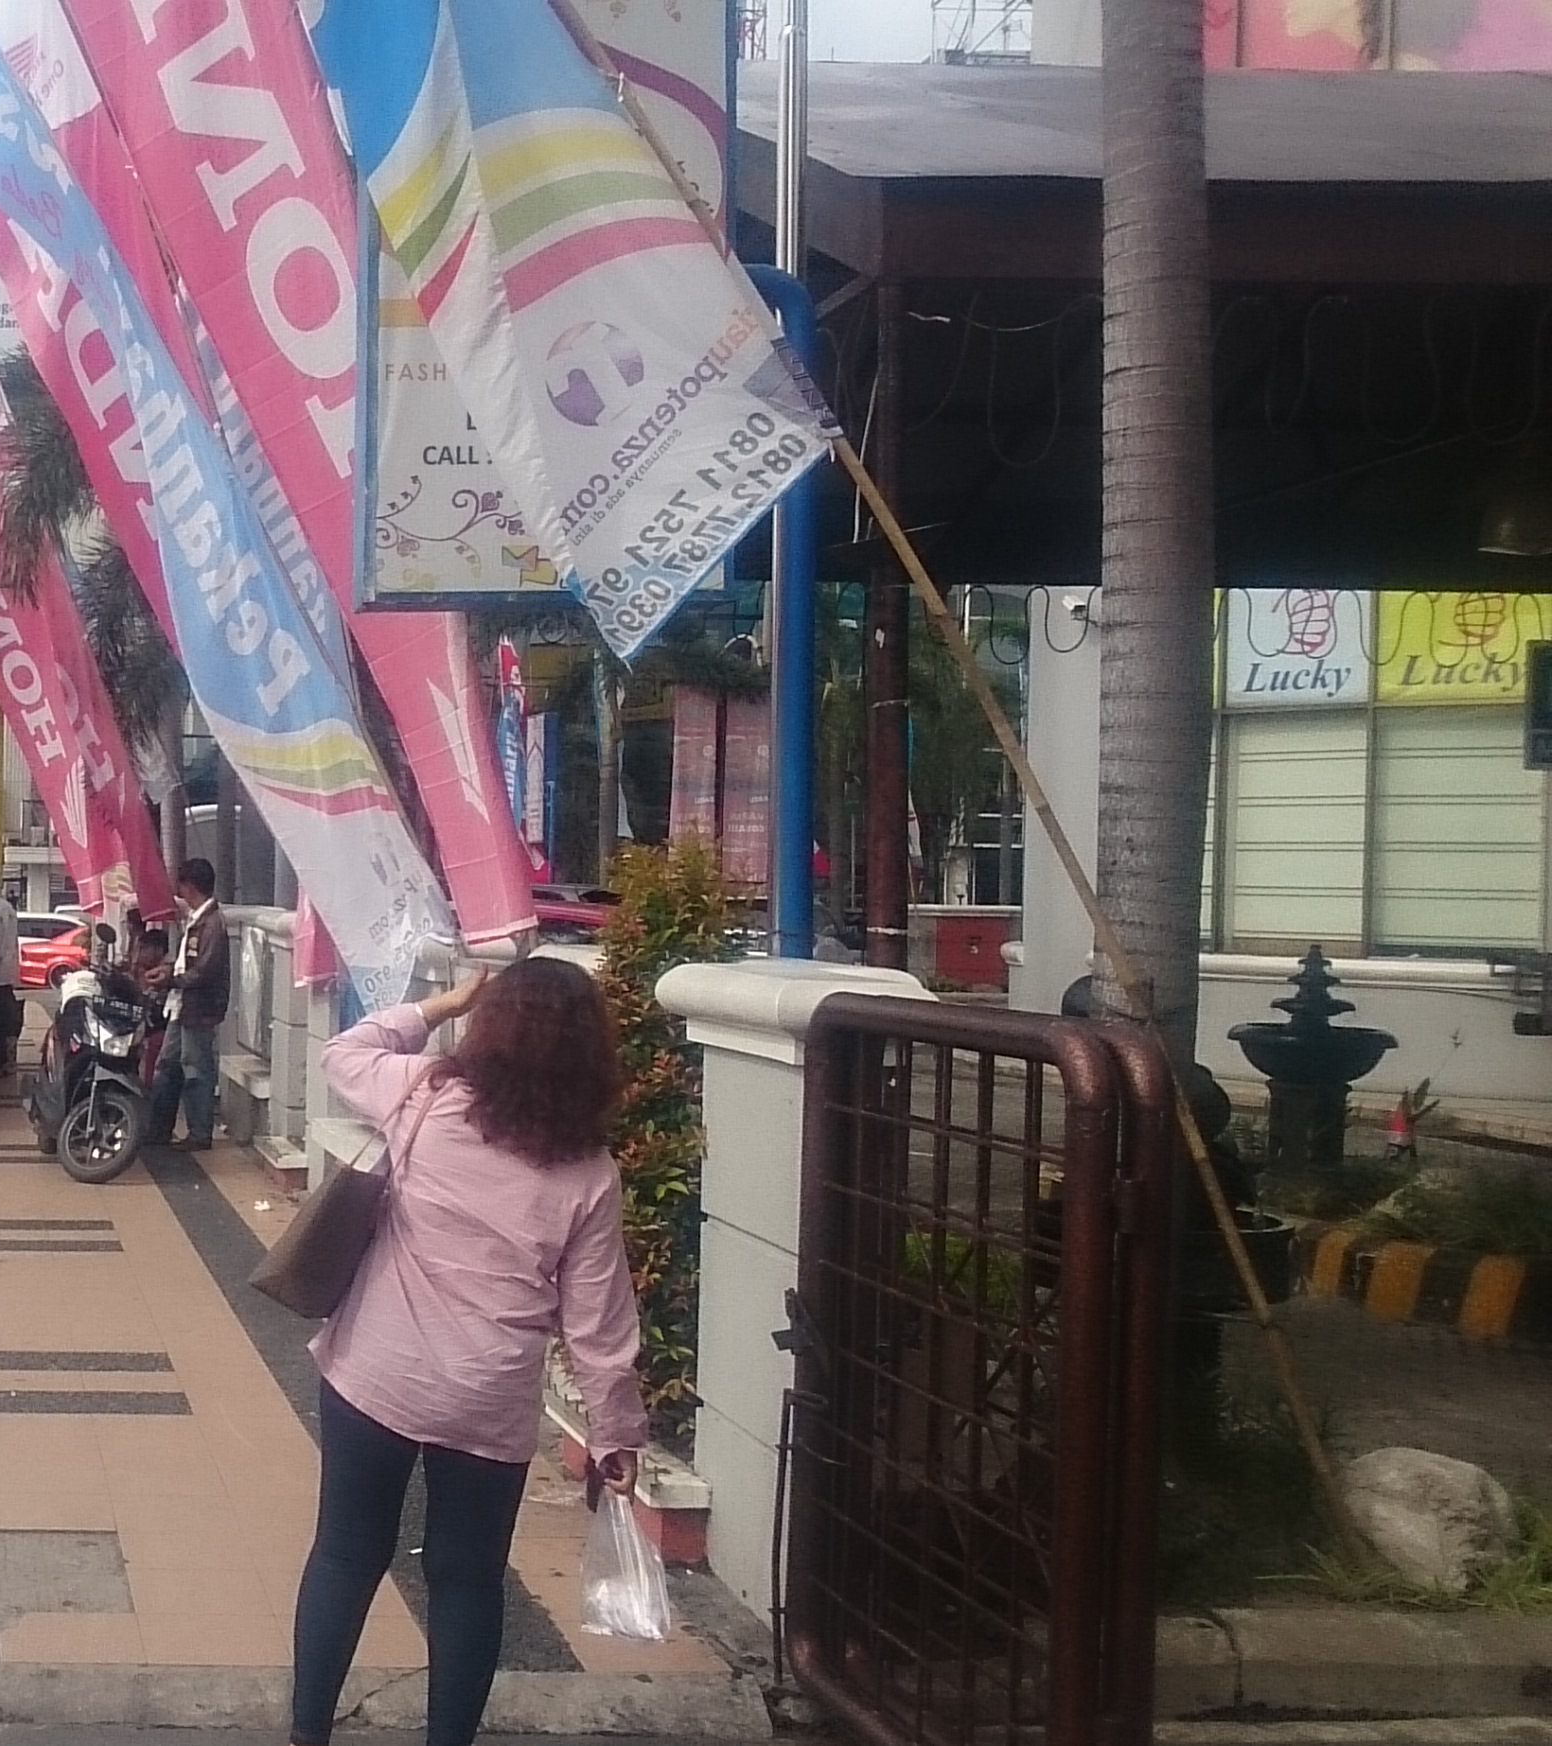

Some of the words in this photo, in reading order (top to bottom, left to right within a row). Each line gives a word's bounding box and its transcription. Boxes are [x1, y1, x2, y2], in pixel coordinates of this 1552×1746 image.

[422, 445, 479, 465] CALL
[1243, 659, 1352, 697] Lucky
[1397, 652, 1529, 692] Lucky
